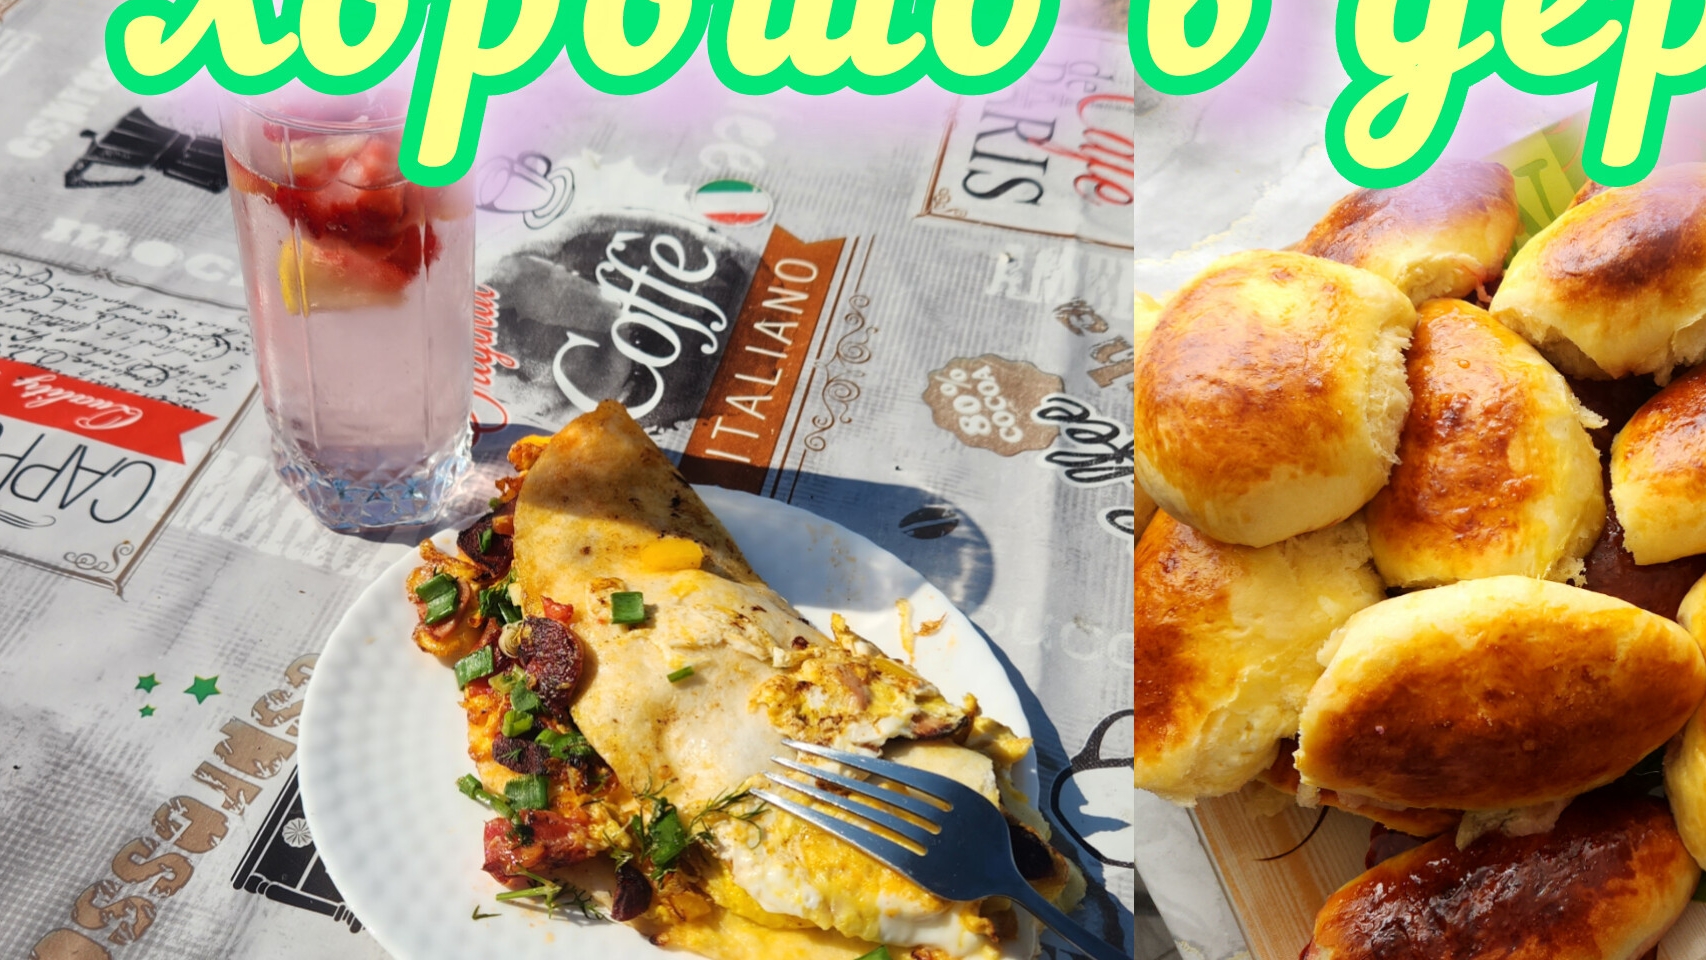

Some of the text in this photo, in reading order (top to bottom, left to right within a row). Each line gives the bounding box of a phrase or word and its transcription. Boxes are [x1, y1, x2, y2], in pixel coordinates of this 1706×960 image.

[42, 217, 244, 286] moc
[553, 231, 728, 420] Coffee
[704, 256, 820, 463] ITALIANO
[13, 373, 144, 431] Quality
[938, 368, 989, 439] 80%
[973, 364, 1024, 444] COCOA
